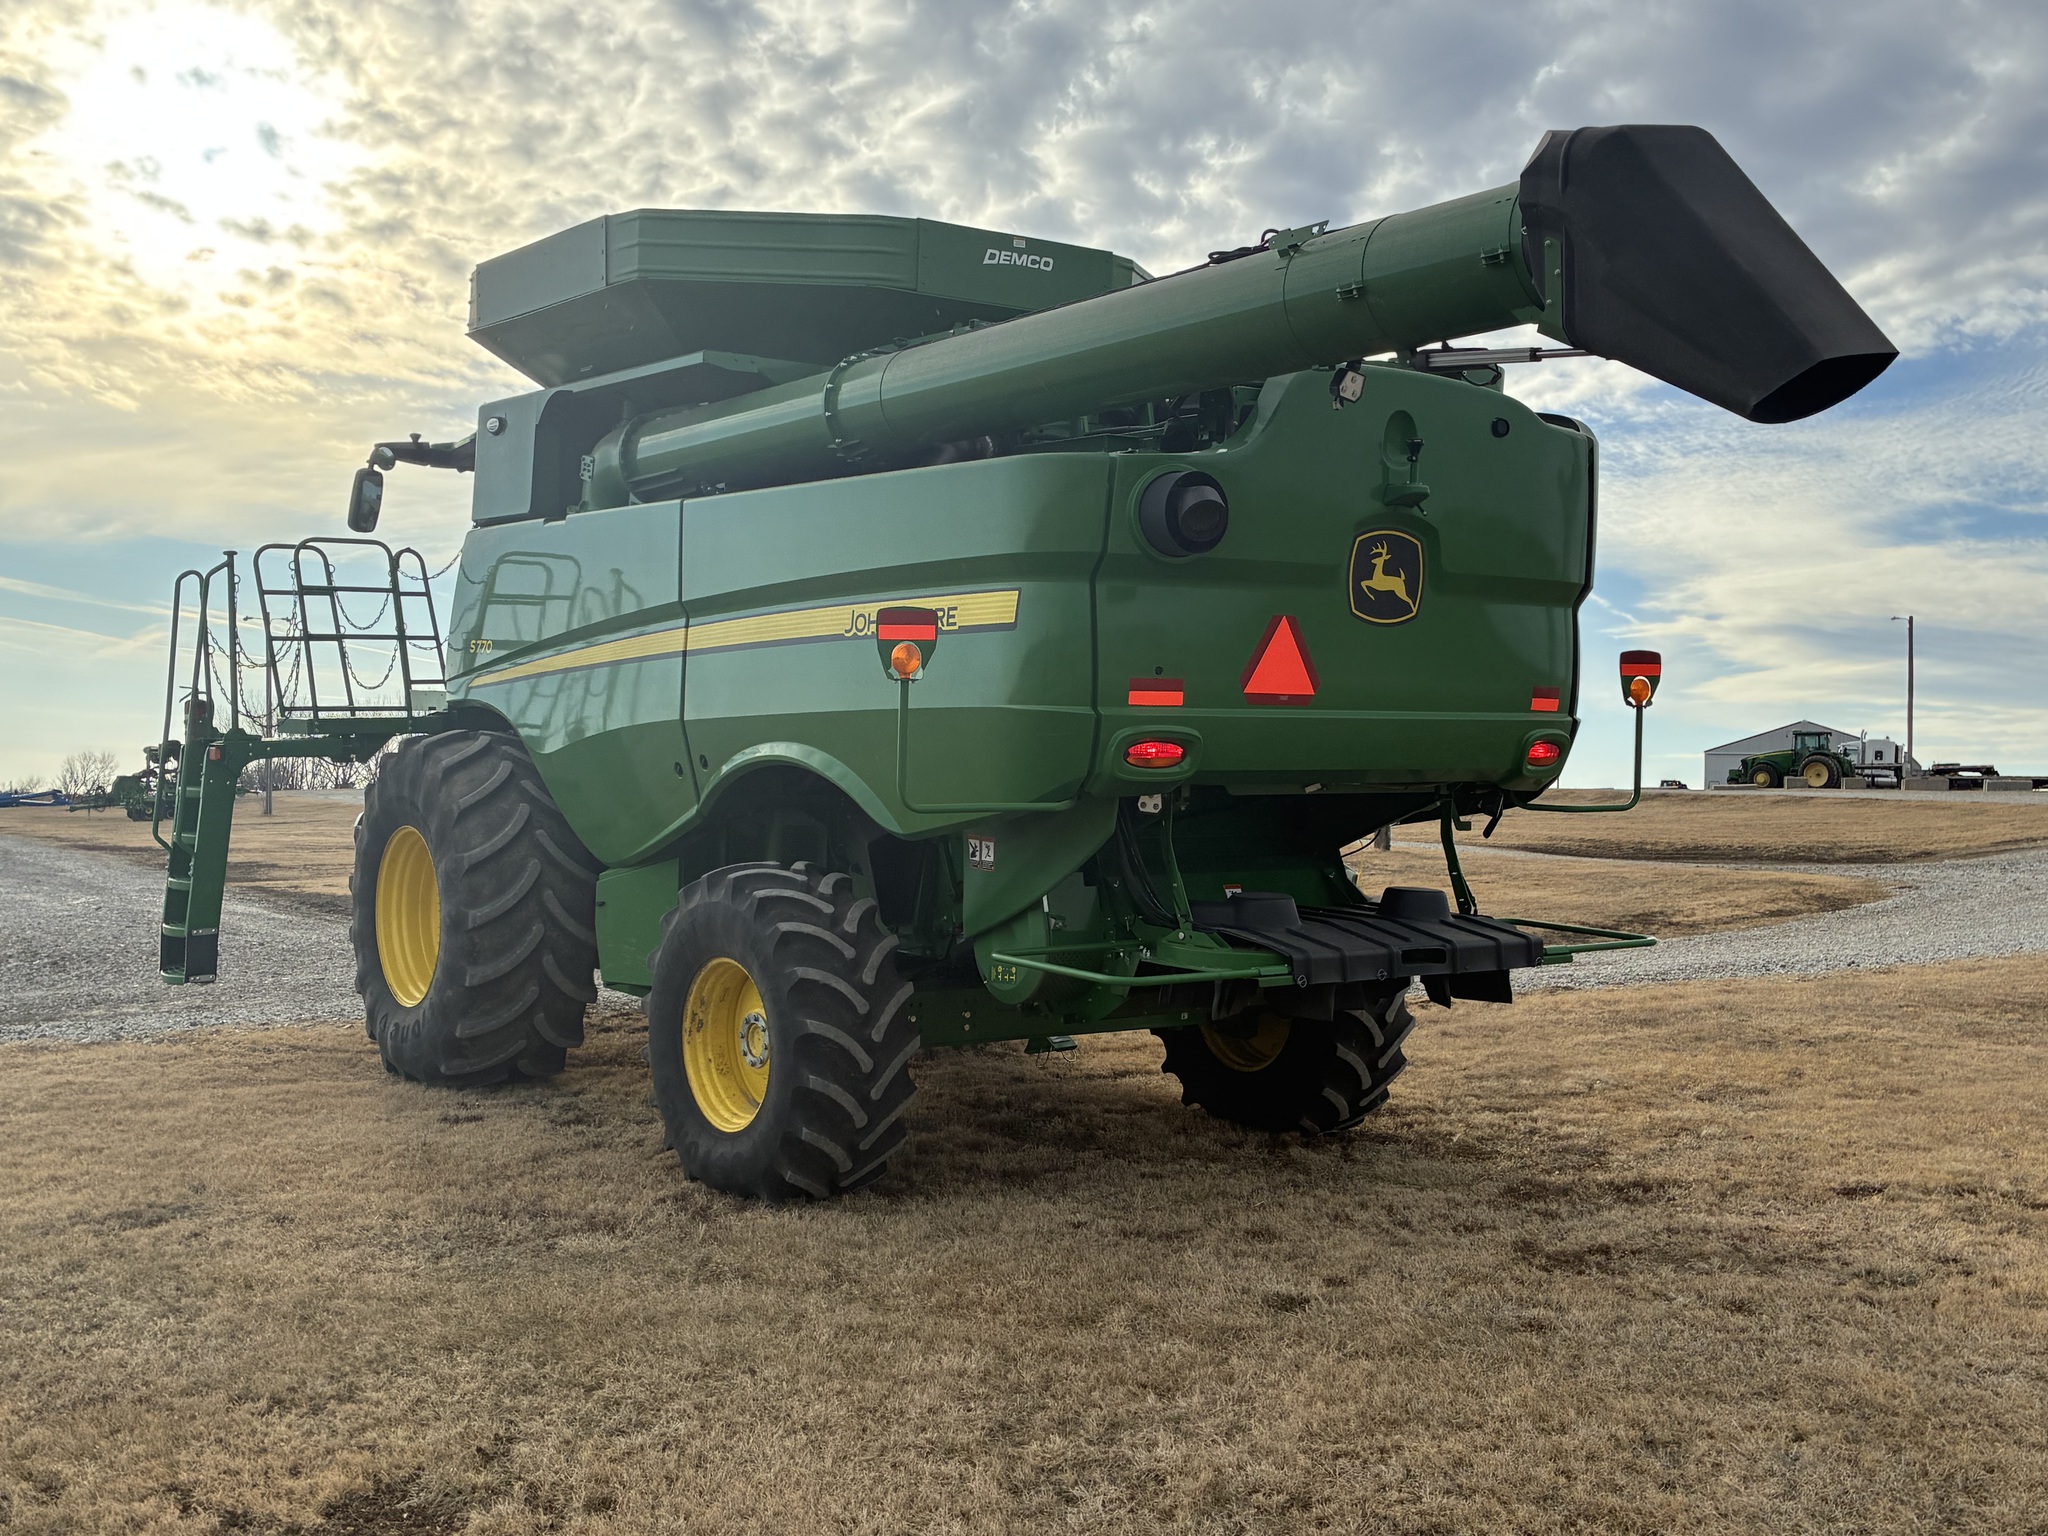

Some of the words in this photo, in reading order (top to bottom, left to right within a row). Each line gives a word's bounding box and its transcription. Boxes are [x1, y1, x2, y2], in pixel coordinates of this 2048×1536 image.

[982, 248, 1054, 272] DEMCO
[844, 609, 878, 634] JOH
[469, 639, 493, 654] S770
